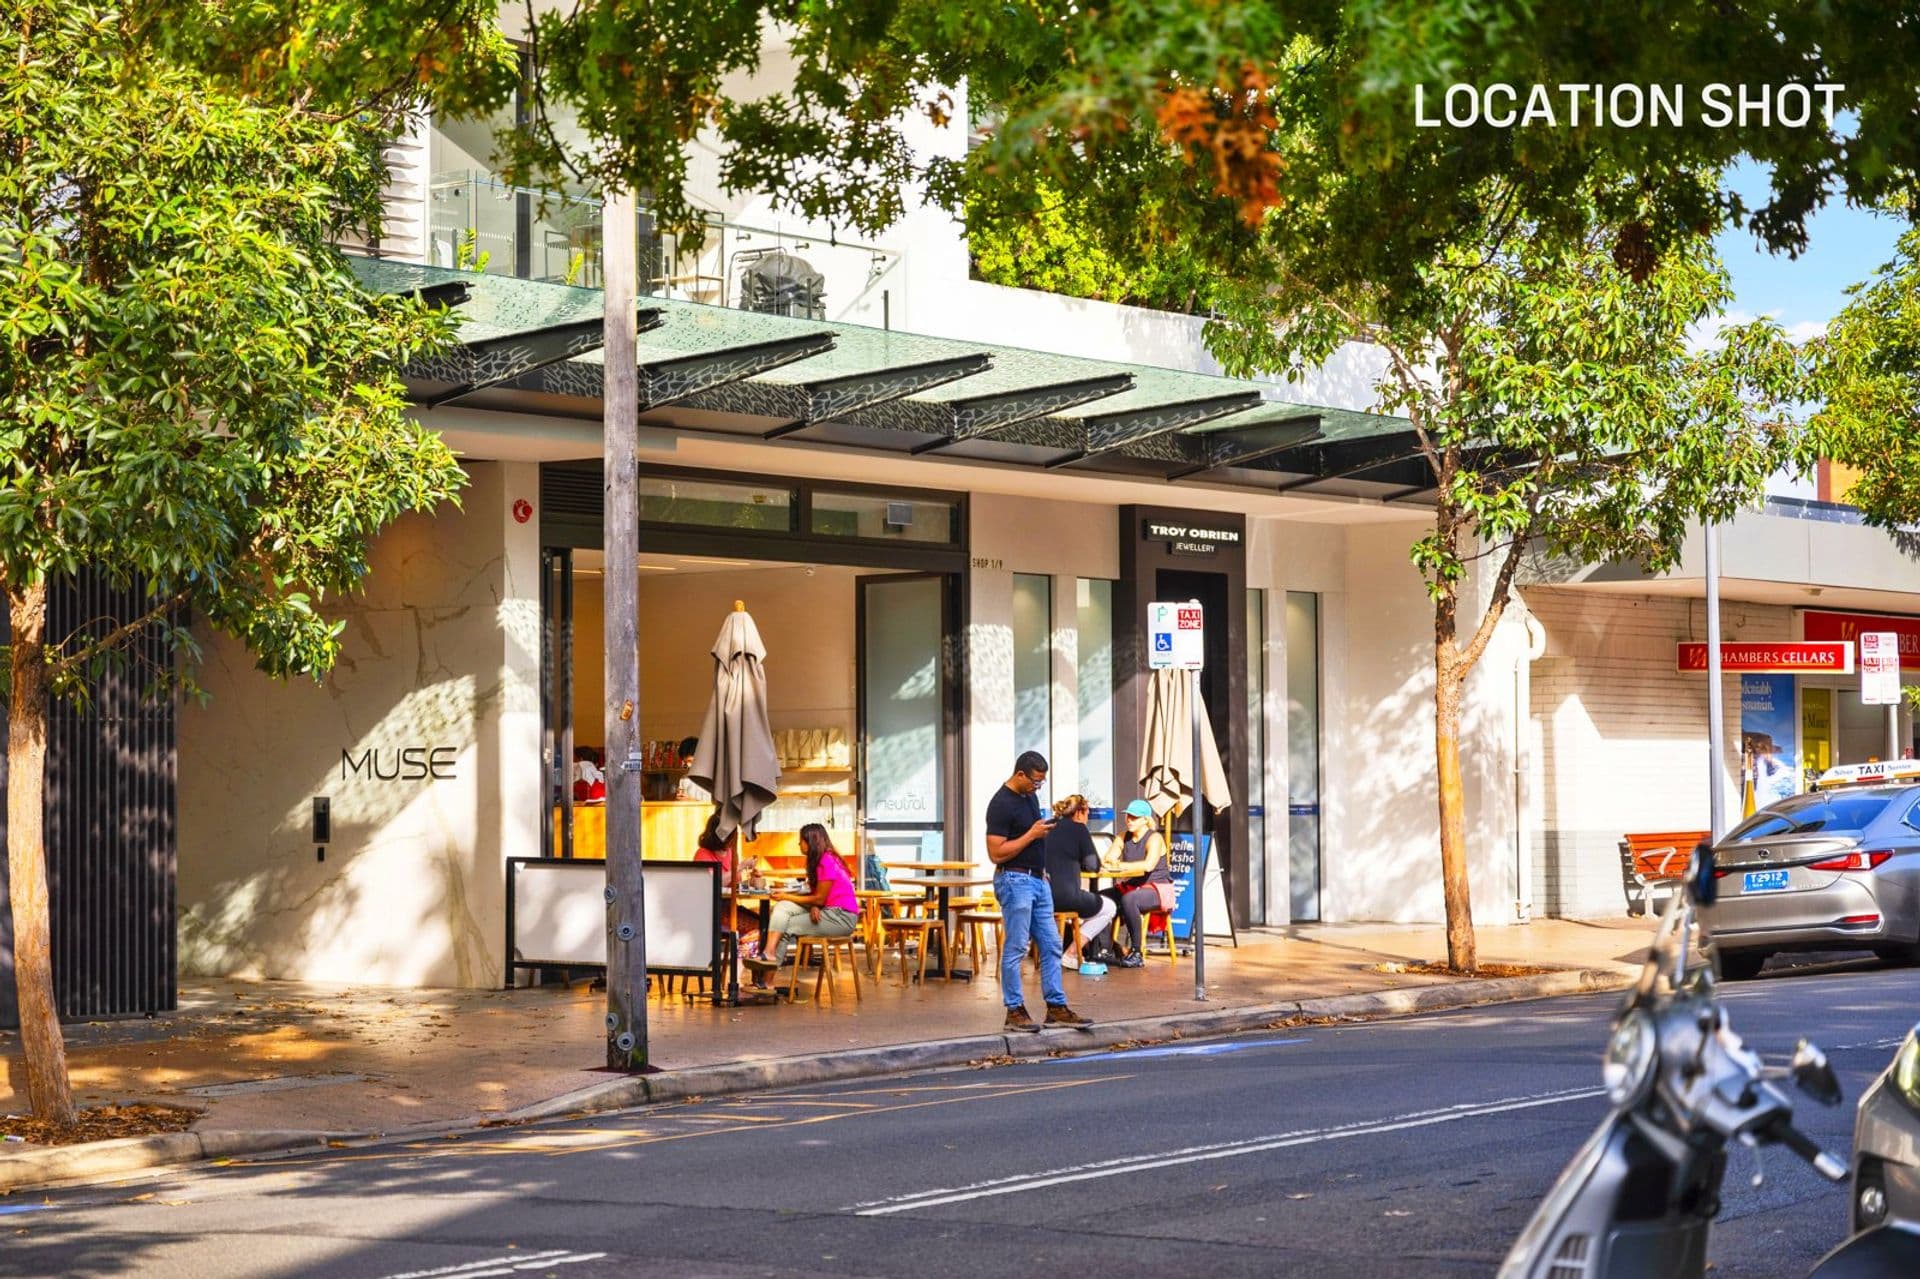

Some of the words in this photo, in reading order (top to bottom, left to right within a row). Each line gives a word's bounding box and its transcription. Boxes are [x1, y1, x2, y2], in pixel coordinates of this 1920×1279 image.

[1150, 525, 1187, 537] TROY
[1189, 529, 1239, 541] OBRIEN
[1176, 542, 1215, 552] JEWELLERY
[972, 557, 989, 568] SHOP
[1157, 607, 1169, 622] P
[1178, 610, 1201, 620] TAXI
[1178, 620, 1201, 630] ZONE
[1720, 651, 1779, 663] HAMBERS
[1782, 652, 1836, 663] CELLARS
[342, 747, 457, 780] MUSE
[1857, 764, 1884, 775] TAXI
